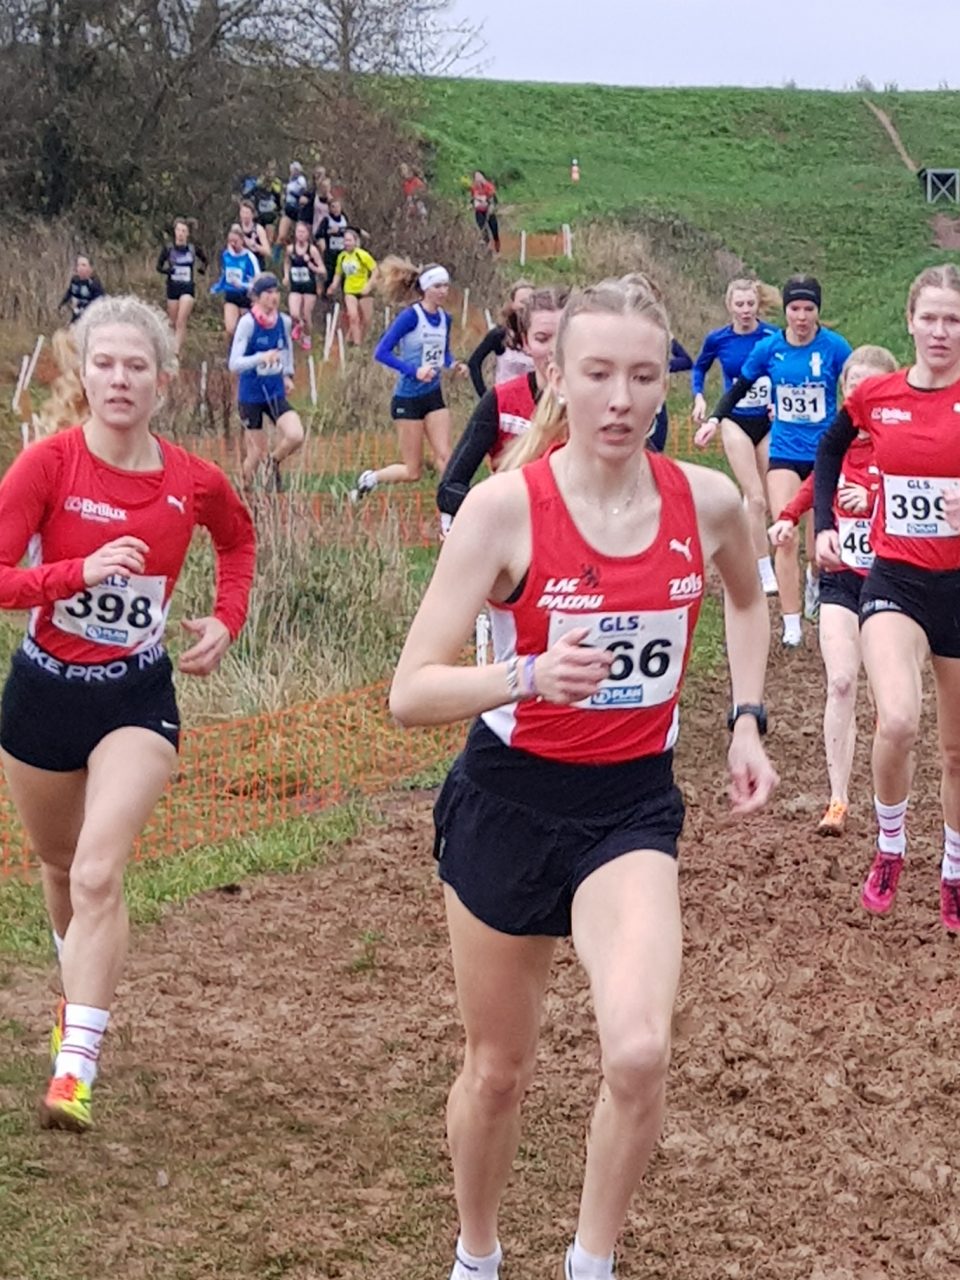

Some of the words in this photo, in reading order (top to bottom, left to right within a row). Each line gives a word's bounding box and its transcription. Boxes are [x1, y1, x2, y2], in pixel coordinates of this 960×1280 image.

[782, 396, 818, 414] 931
[907, 480, 930, 490] GLS
[544, 579, 580, 593] LAC
[65, 591, 153, 629] 398
[536, 594, 605, 609] PASSAU
[599, 615, 640, 633] GLS
[578, 638, 672, 682] 66
[65, 661, 128, 682] PRO
